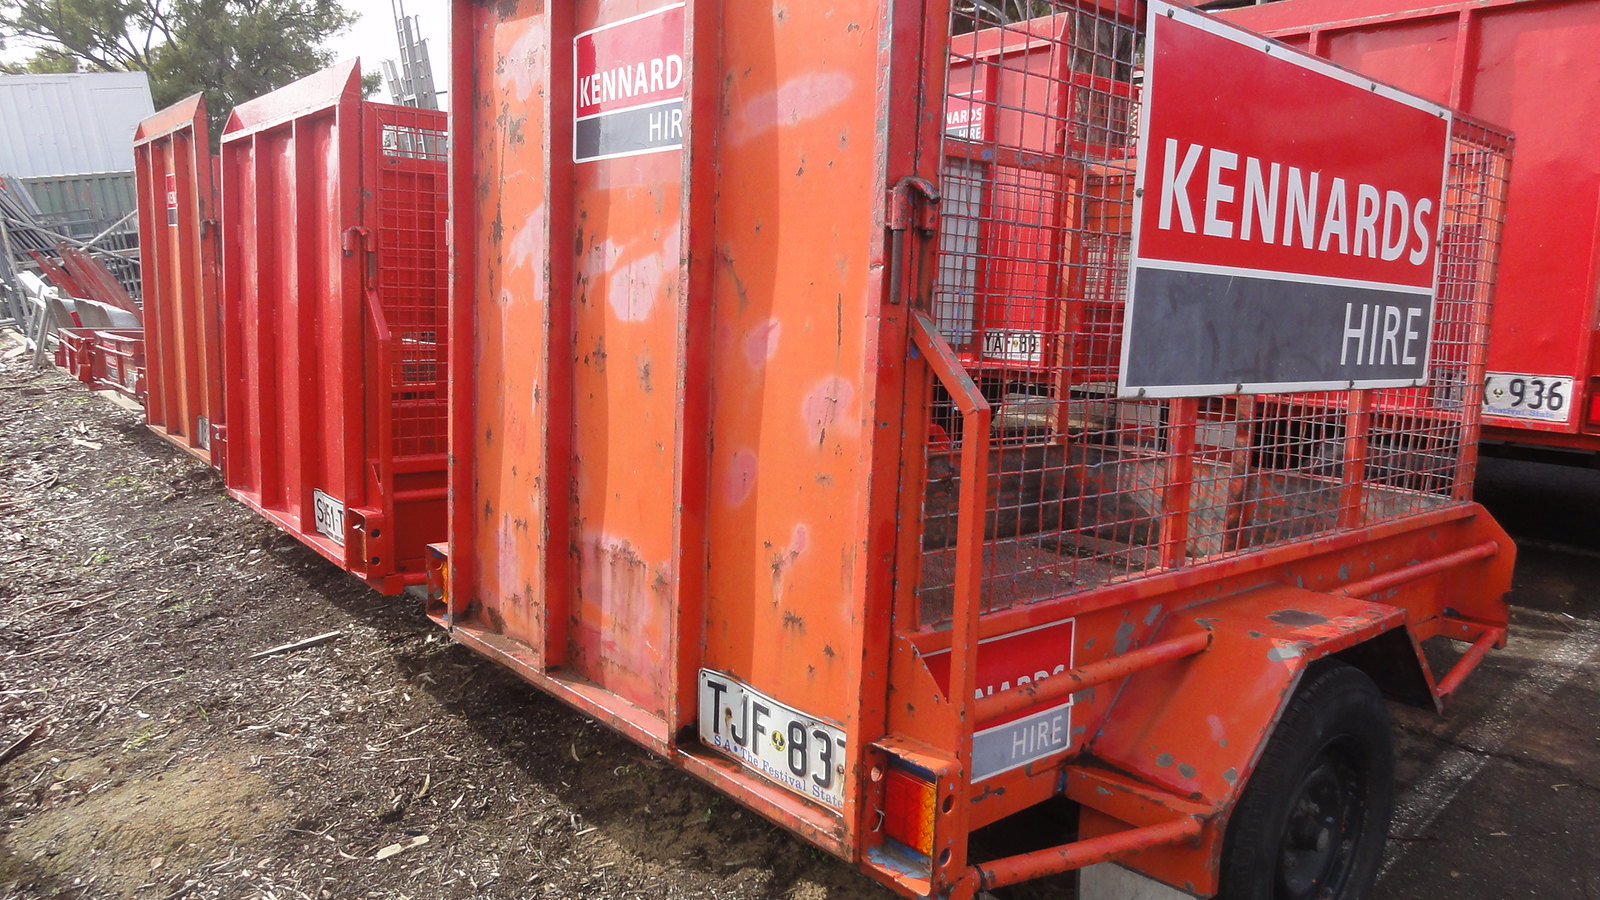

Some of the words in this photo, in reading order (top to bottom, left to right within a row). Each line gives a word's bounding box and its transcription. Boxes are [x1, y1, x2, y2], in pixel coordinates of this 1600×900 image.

[580, 54, 683, 108] KENNARD
[649, 108, 683, 142] HIR
[1158, 137, 1432, 266] KENNARDS
[1340, 302, 1422, 365] HIRE
[1509, 378, 1563, 411] 936
[707, 679, 770, 756] TJF
[1012, 715, 1062, 760] HIRE
[741, 747, 758, 768] The
[762, 760, 807, 792] Festival
[812, 784, 843, 809] State
